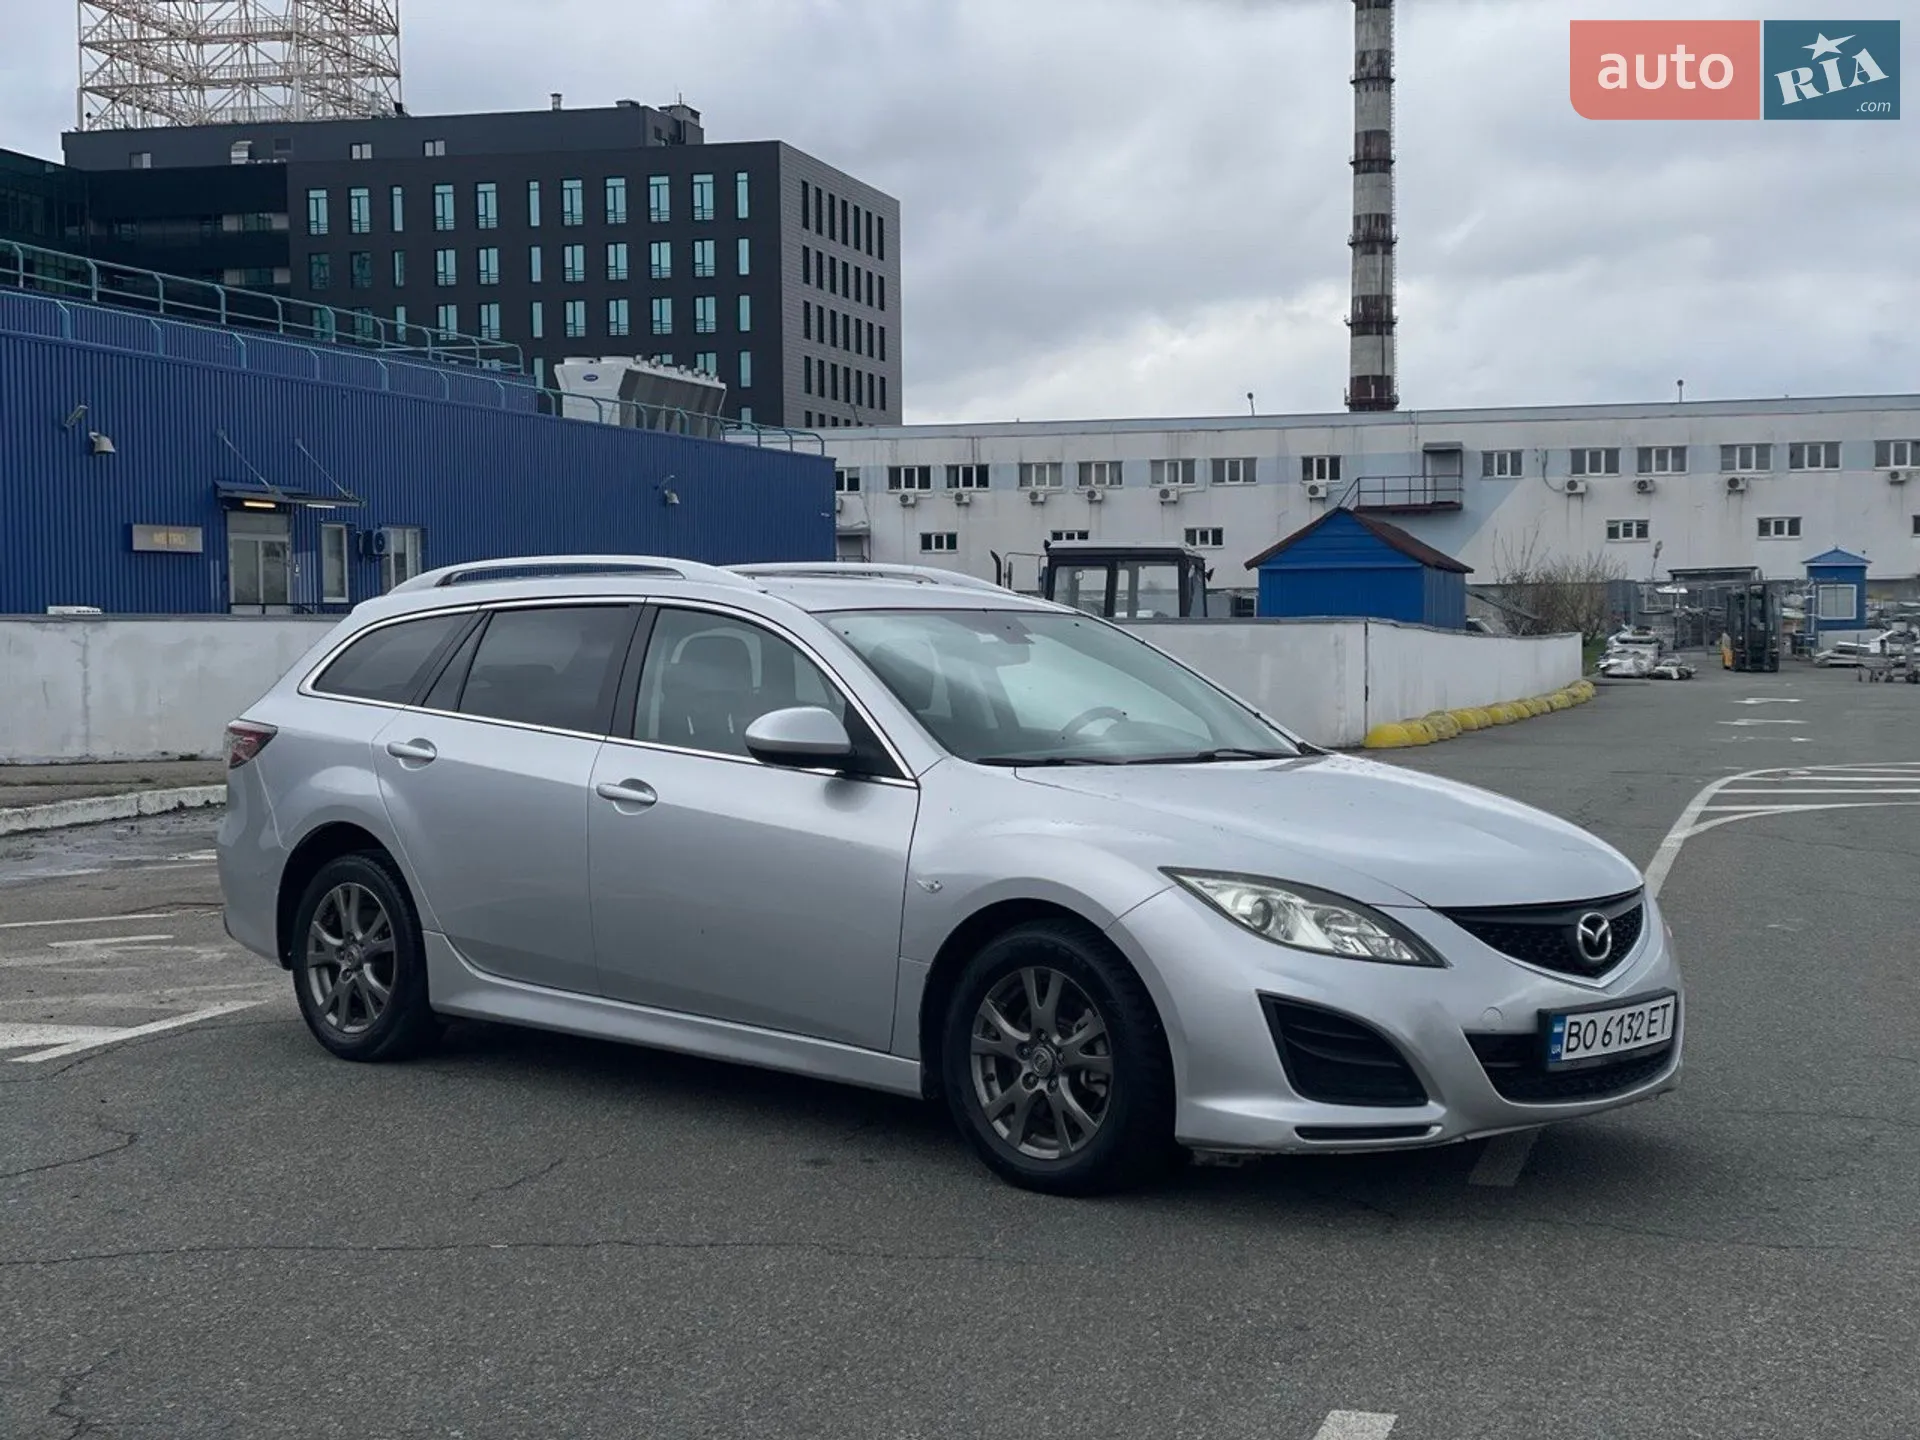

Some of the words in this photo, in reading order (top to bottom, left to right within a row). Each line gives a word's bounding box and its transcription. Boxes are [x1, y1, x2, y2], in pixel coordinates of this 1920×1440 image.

[1565, 1019, 1598, 1053] BO
[1601, 1010, 1646, 1048] 6132
[1646, 1002, 1671, 1038] ET
